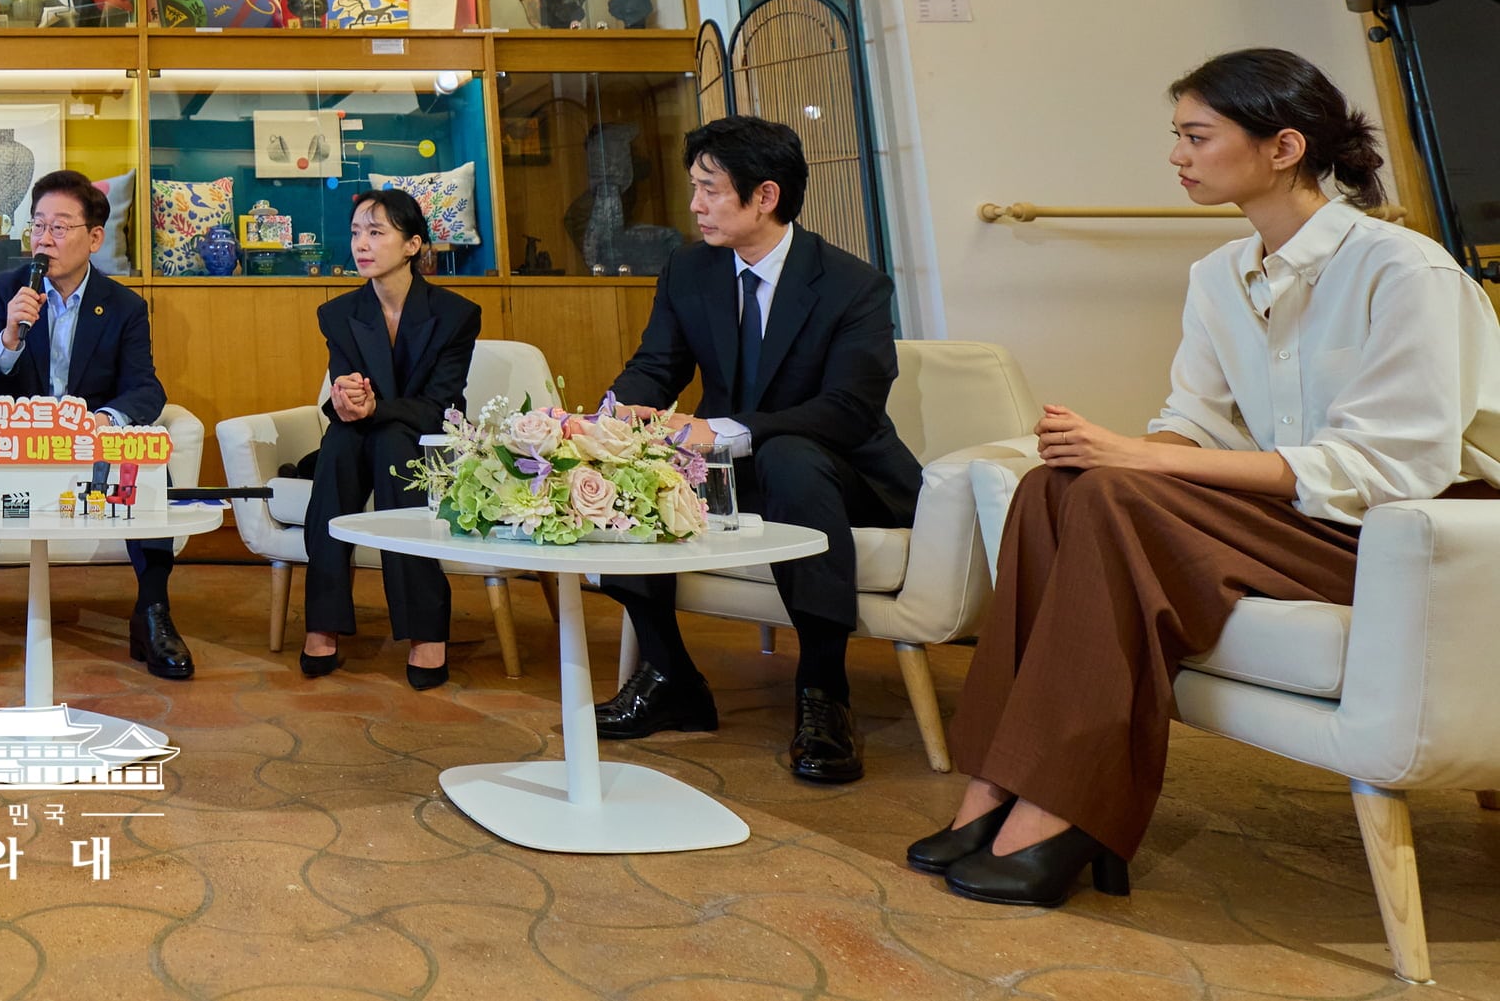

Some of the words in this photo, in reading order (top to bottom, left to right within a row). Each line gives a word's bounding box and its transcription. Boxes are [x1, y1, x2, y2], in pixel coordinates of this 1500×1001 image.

[59, 403, 91, 431] 씬,
[26, 435, 95, 462] 내일을
[101, 434, 170, 462] 말하다
